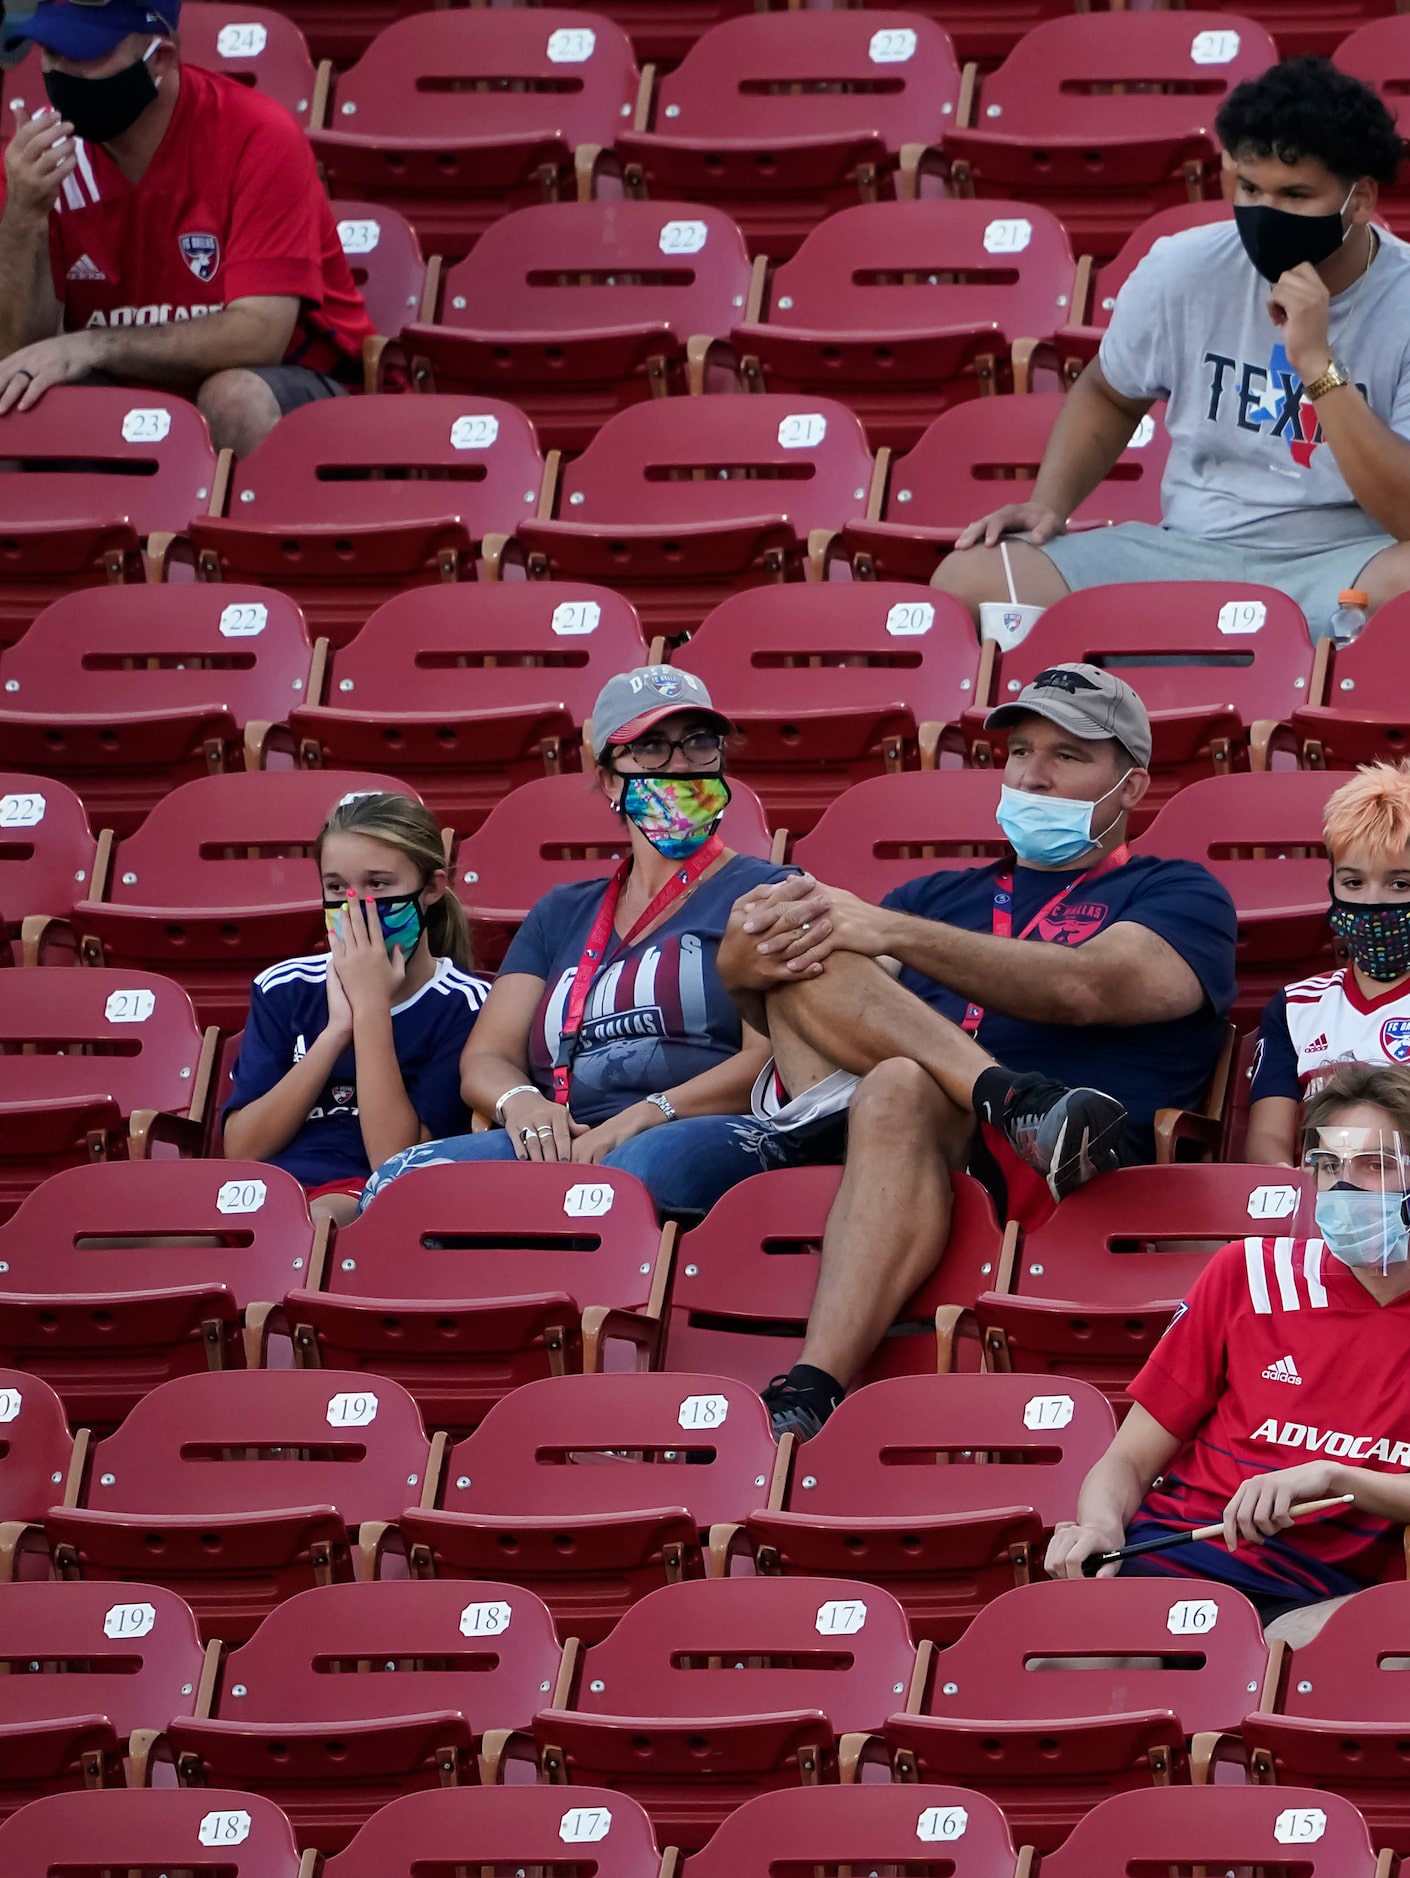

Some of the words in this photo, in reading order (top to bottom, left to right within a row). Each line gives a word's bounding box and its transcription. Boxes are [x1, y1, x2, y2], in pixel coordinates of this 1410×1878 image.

[228, 29, 255, 52] 24
[879, 33, 907, 57] 22
[1202, 36, 1226, 58] 21
[339, 226, 369, 249] 23
[668, 226, 696, 249] 22
[993, 224, 1018, 247] 21
[132, 414, 159, 436] 23
[460, 420, 487, 443] 22
[788, 419, 812, 442] 21
[229, 608, 257, 631] 22
[562, 607, 587, 629] 21
[895, 607, 925, 630] 20
[1231, 607, 1256, 628] 19
[5, 798, 34, 821] 22
[114, 995, 140, 1017] 21
[226, 1185, 256, 1208] 20
[577, 1188, 604, 1210] 19
[1261, 1190, 1287, 1213] 17
[1262, 1370, 1302, 1386] adidas
[341, 1398, 367, 1420] 19
[692, 1400, 717, 1423] 18
[1037, 1401, 1064, 1424] 17
[117, 1608, 145, 1632] 19
[474, 1607, 500, 1630] 18
[829, 1605, 857, 1629] 17
[1182, 1606, 1207, 1628] 16
[213, 1816, 240, 1840] 18
[573, 1812, 601, 1836] 17
[931, 1812, 956, 1835] 16
[1289, 1814, 1316, 1837] 15
